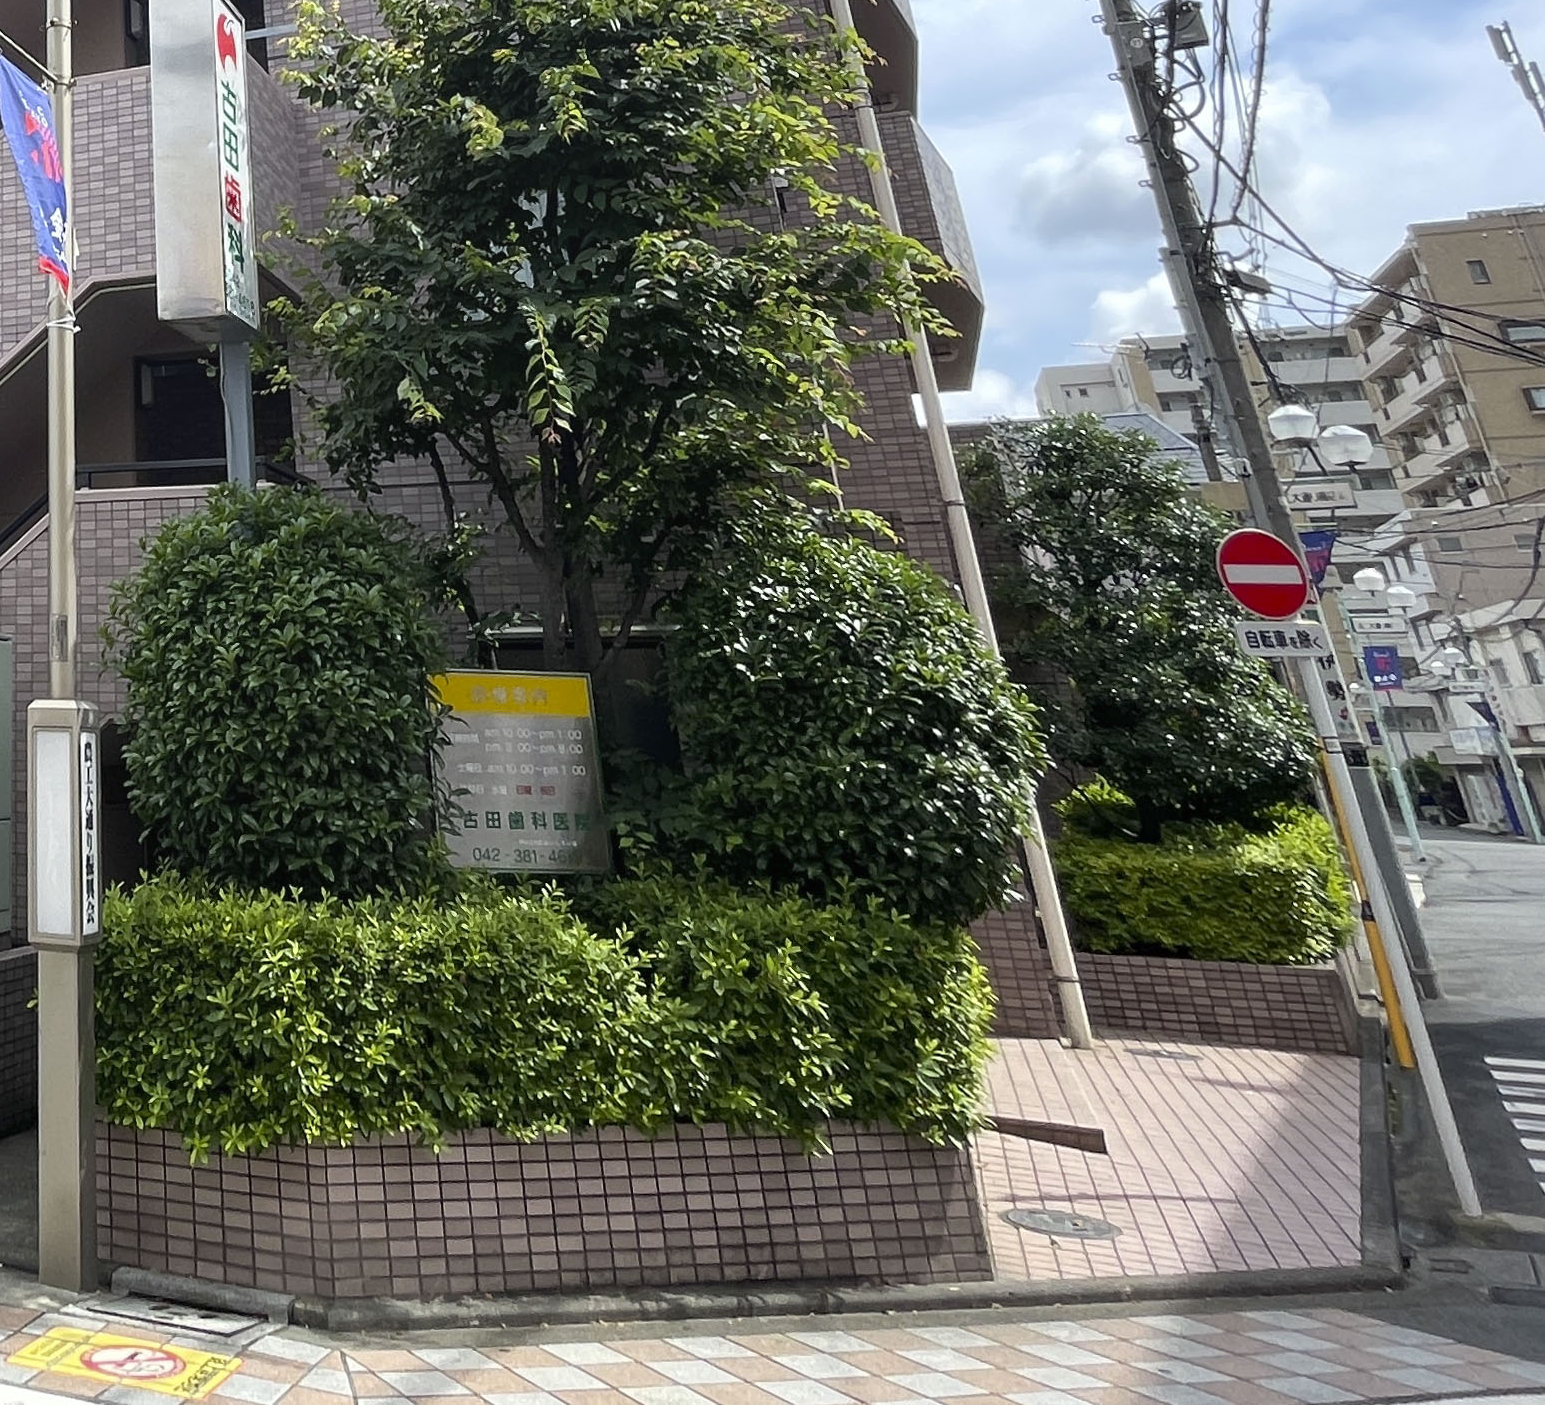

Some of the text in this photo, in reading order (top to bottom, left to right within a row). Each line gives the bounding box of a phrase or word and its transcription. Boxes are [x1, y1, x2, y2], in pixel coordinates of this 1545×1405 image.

[221, 79, 245, 274] 古田歯科
[1244, 629, 1324, 650] 自転車を除く
[463, 810, 591, 831] 古田歯科医院
